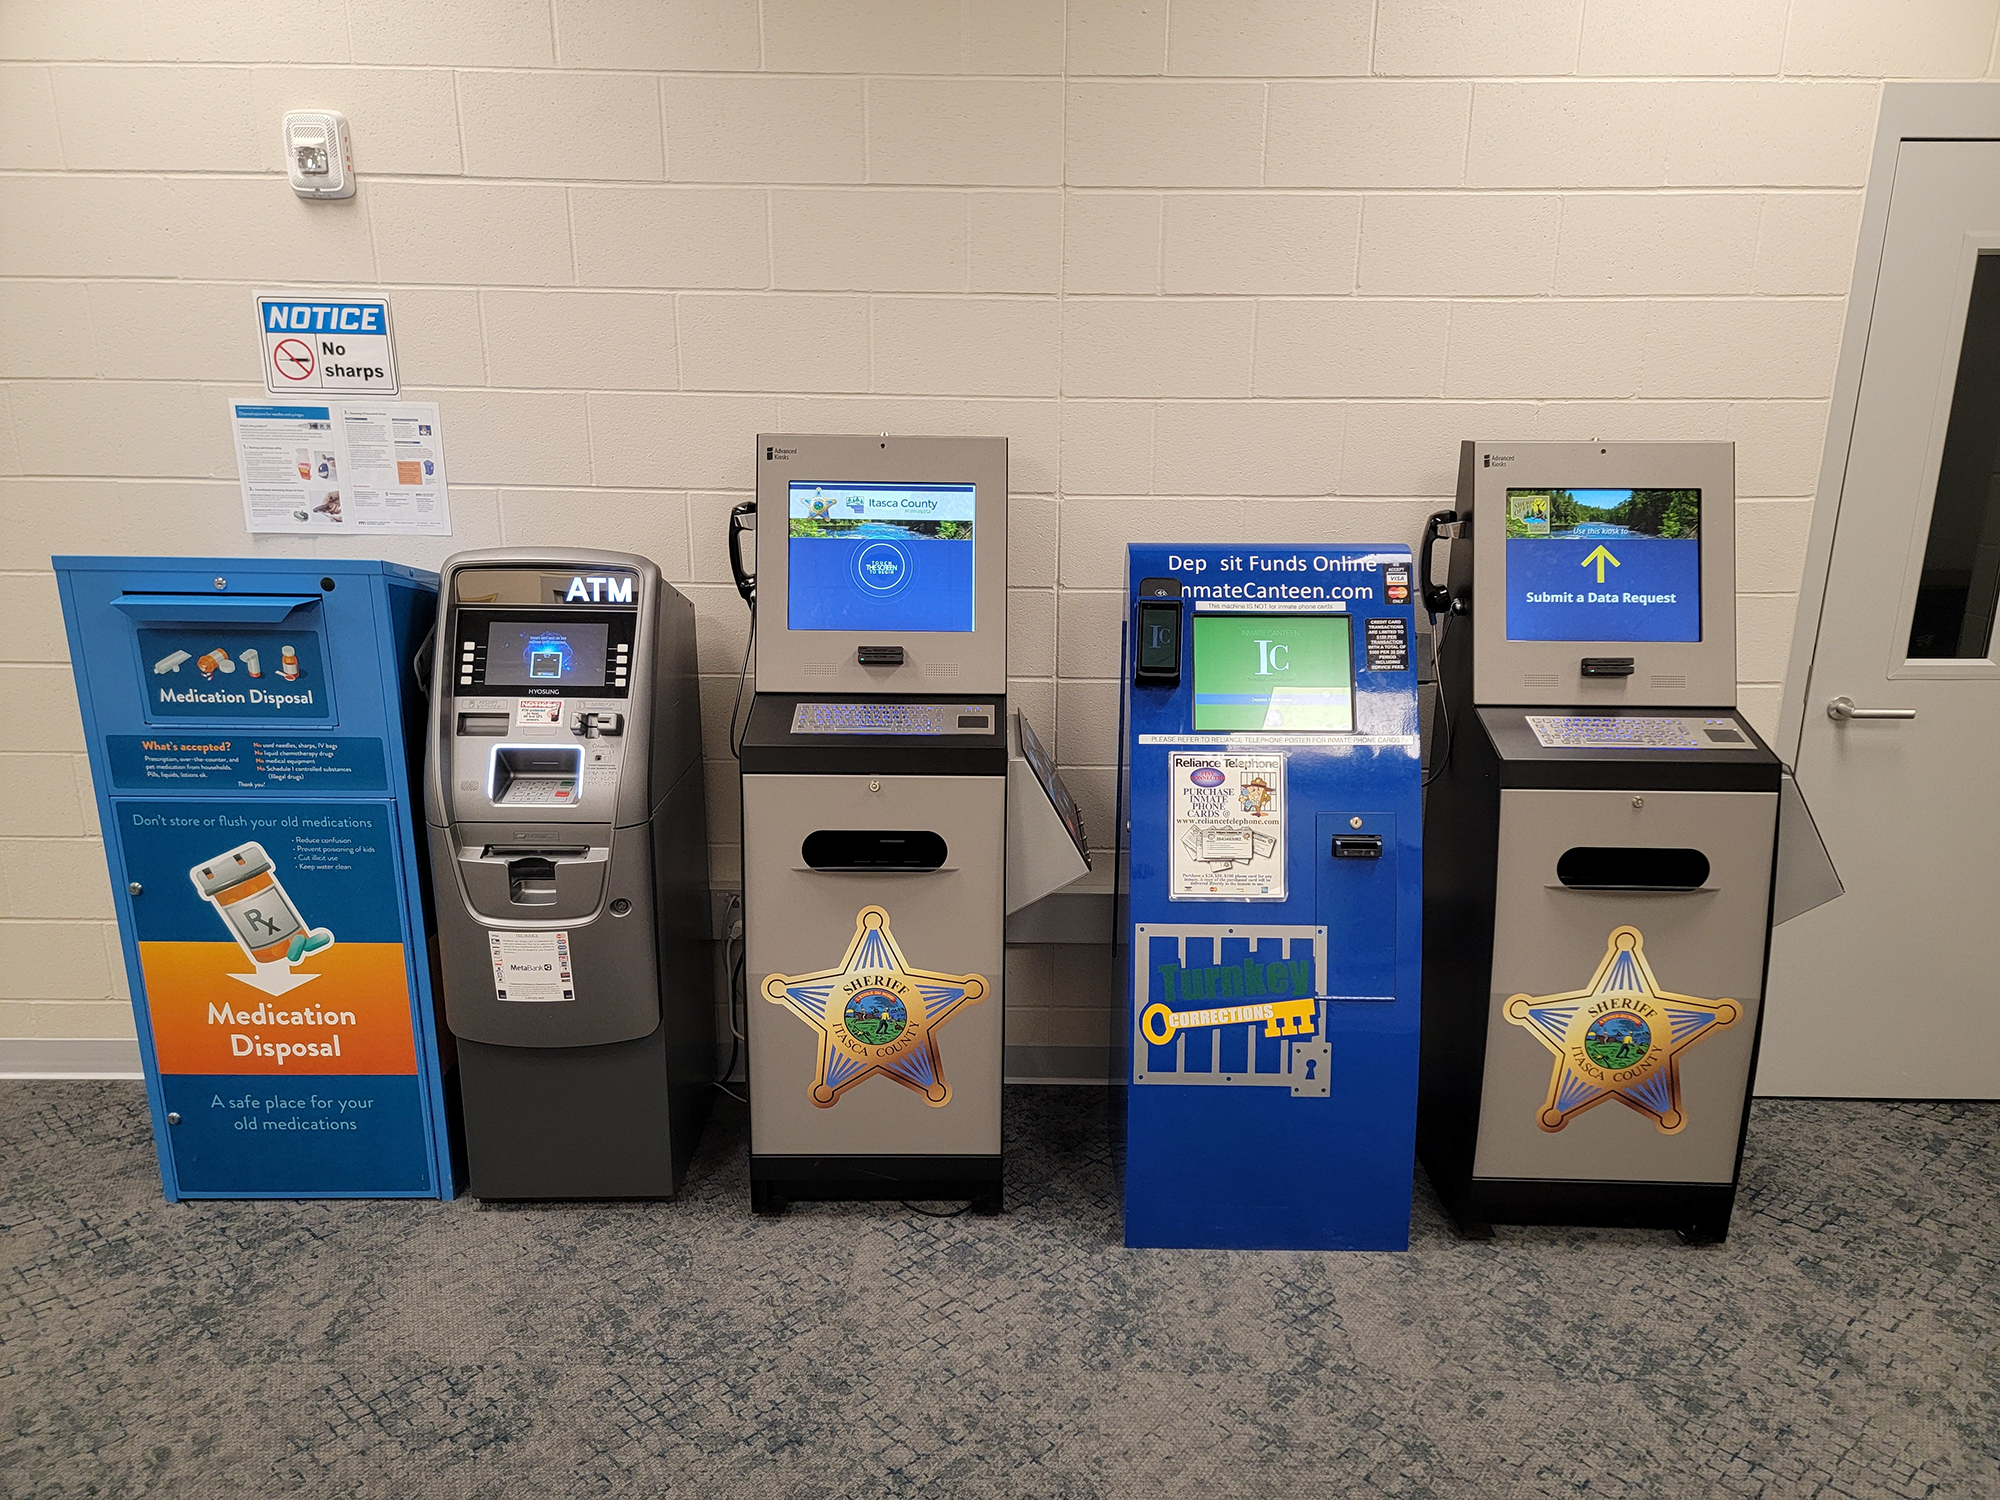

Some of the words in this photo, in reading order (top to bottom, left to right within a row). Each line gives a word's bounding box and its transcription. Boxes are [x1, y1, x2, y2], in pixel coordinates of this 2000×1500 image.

[269, 306, 379, 330] NOTICE
[322, 342, 346, 356] No
[325, 364, 384, 381] sharps
[869, 500, 898, 508] Itasca
[901, 499, 938, 510] County
[1573, 527, 1587, 535] Use
[1589, 526, 1600, 535] this
[1601, 526, 1620, 535] kiosk
[1250, 556, 1307, 571] Funds
[1314, 556, 1377, 572] Online
[566, 576, 632, 602] ATM
[1181, 582, 1373, 599] nmateCanteen.com
[1526, 592, 1574, 603] Submit
[1576, 594, 1584, 603] a
[1589, 593, 1619, 603] Data
[1622, 593, 1676, 606] Request
[160, 688, 246, 704] Medication
[250, 690, 313, 709] Disposal
[142, 741, 178, 750] What's
[180, 742, 231, 754] accepted?
[1176, 758, 1221, 768] Reliance
[1224, 758, 1279, 770] Telephone
[133, 814, 167, 827] Don't
[170, 817, 200, 827] store
[203, 818, 216, 827] or
[219, 815, 248, 828] flush
[250, 818, 278, 834] your
[280, 815, 299, 828] old
[302, 816, 373, 828] medications
[842, 975, 910, 996] SHERIFF
[1158, 958, 1310, 1001] Turnkey
[208, 1001, 356, 1025] Medication
[1169, 1004, 1274, 1028] CORRECTIONS
[1588, 998, 1658, 1019] SHERIFF
[832, 1022, 868, 1057] ITASCA
[876, 1020, 920, 1058] COUNTY
[231, 1034, 341, 1066] Disposal
[1571, 1046, 1605, 1081] ITASCA
[1612, 1044, 1663, 1082] COUNTY
[211, 1095, 226, 1108] A
[229, 1094, 260, 1109] safe
[266, 1095, 306, 1114] place
[311, 1094, 333, 1108] for
[338, 1098, 374, 1114] your
[234, 1117, 258, 1130] old
[262, 1117, 358, 1131] medications
